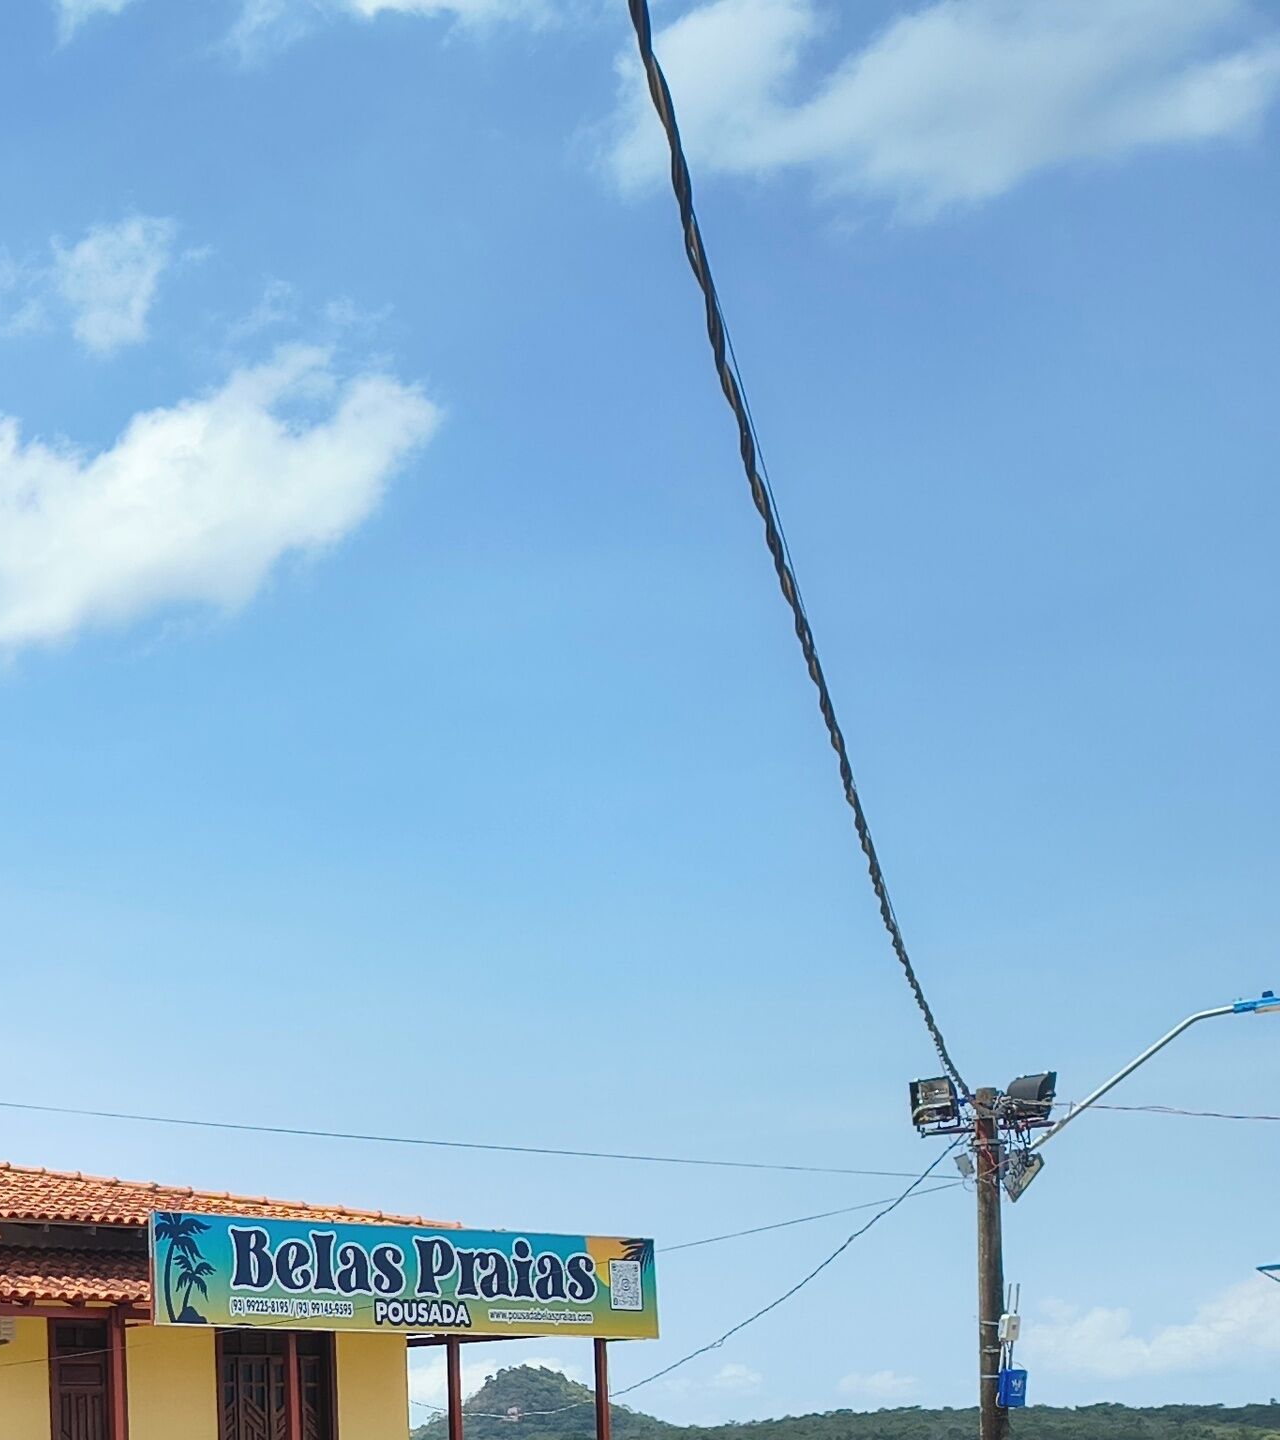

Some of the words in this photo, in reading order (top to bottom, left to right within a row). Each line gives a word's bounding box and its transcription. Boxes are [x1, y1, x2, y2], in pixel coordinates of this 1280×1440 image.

[230, 1229, 403, 1294] Belas
[414, 1238, 595, 1300] Praias
[231, 1298, 245, 1315] (93)
[246, 1299, 289, 1313] 99225-8195
[295, 1300, 310, 1316] (93)
[375, 1301, 470, 1324] POUSADA
